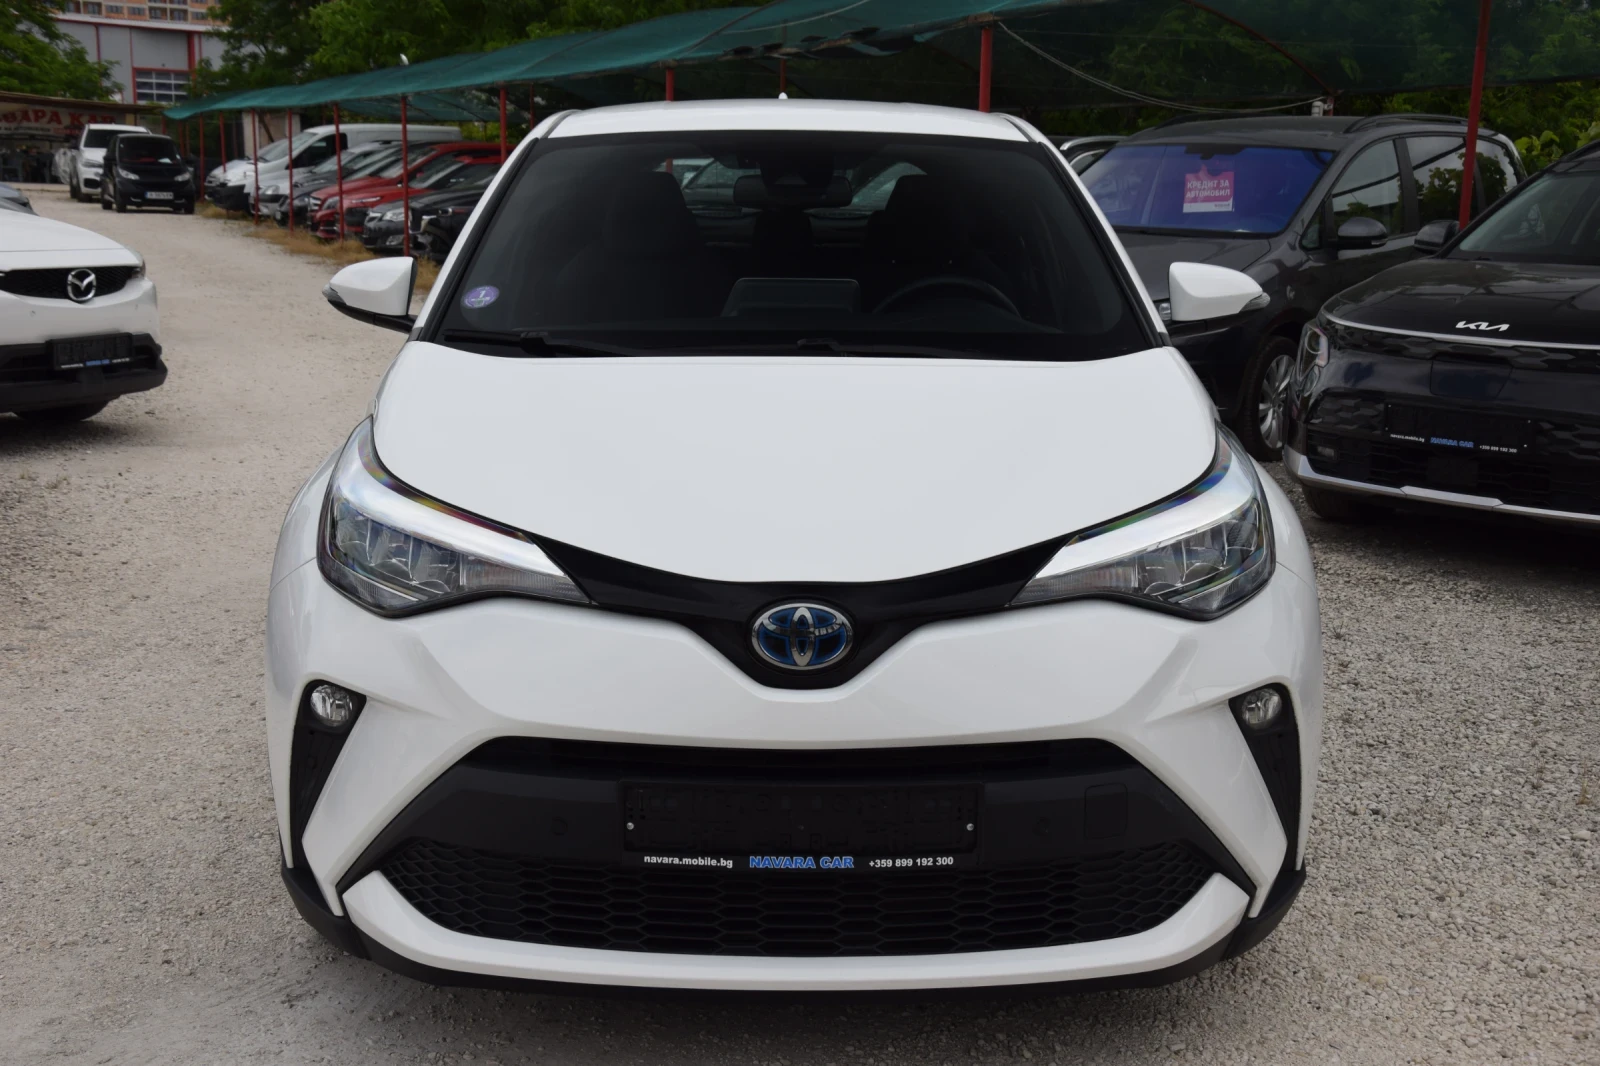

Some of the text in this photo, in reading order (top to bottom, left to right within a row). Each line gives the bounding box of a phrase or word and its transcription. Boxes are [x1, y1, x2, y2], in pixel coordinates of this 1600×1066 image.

[0, 108, 62, 125] ВАРА
[1187, 181, 1217, 189] КРЕДИТ
[1185, 189, 1230, 198] АВТОМОБИЛ
[644, 854, 954, 868] navara.mobile.bg NAVARA CAR +359 899 192 300
